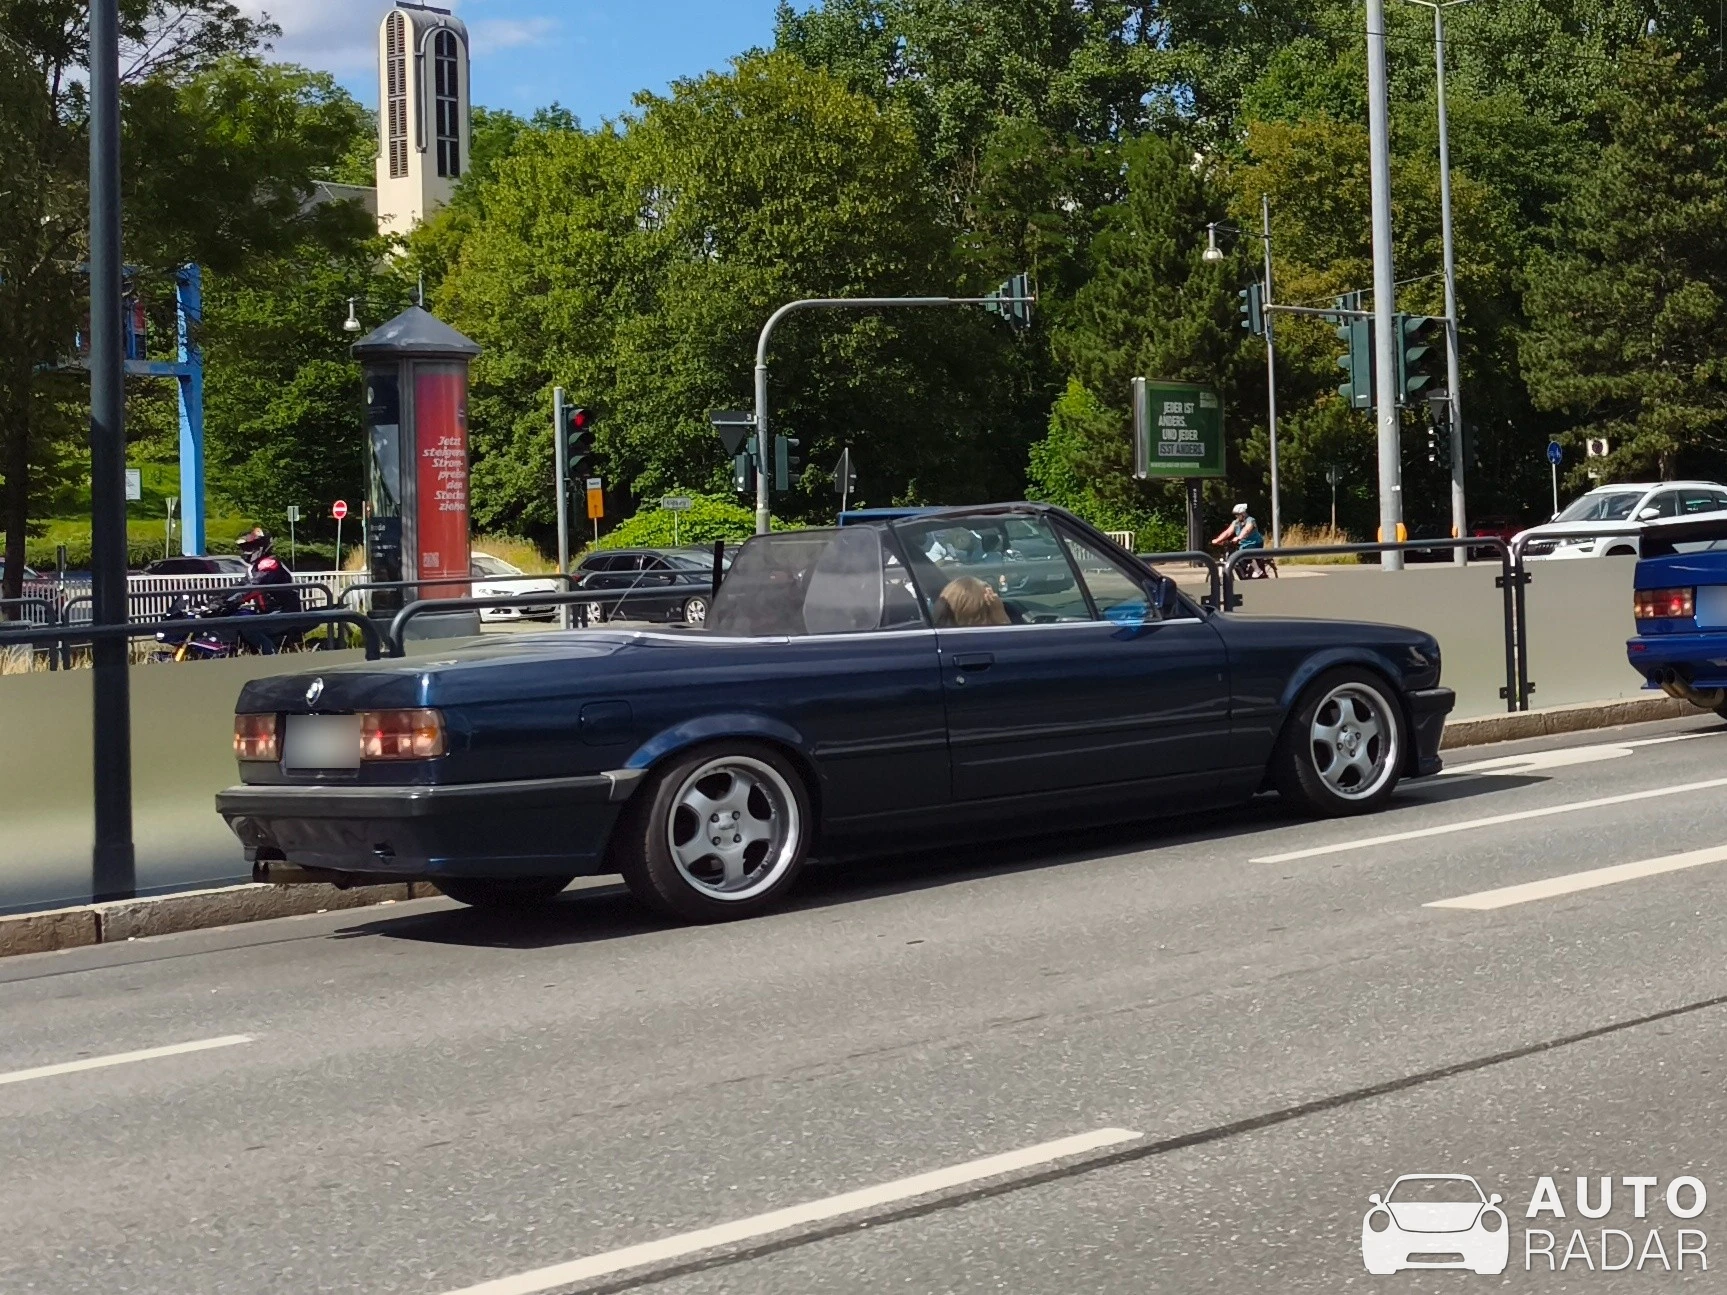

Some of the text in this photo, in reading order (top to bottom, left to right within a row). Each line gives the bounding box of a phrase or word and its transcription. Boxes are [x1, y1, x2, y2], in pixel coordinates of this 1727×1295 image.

[1163, 402, 1195, 414] JEDER IST
[438, 436, 461, 446] Jetzt
[1162, 428, 1198, 442] UND JEDER
